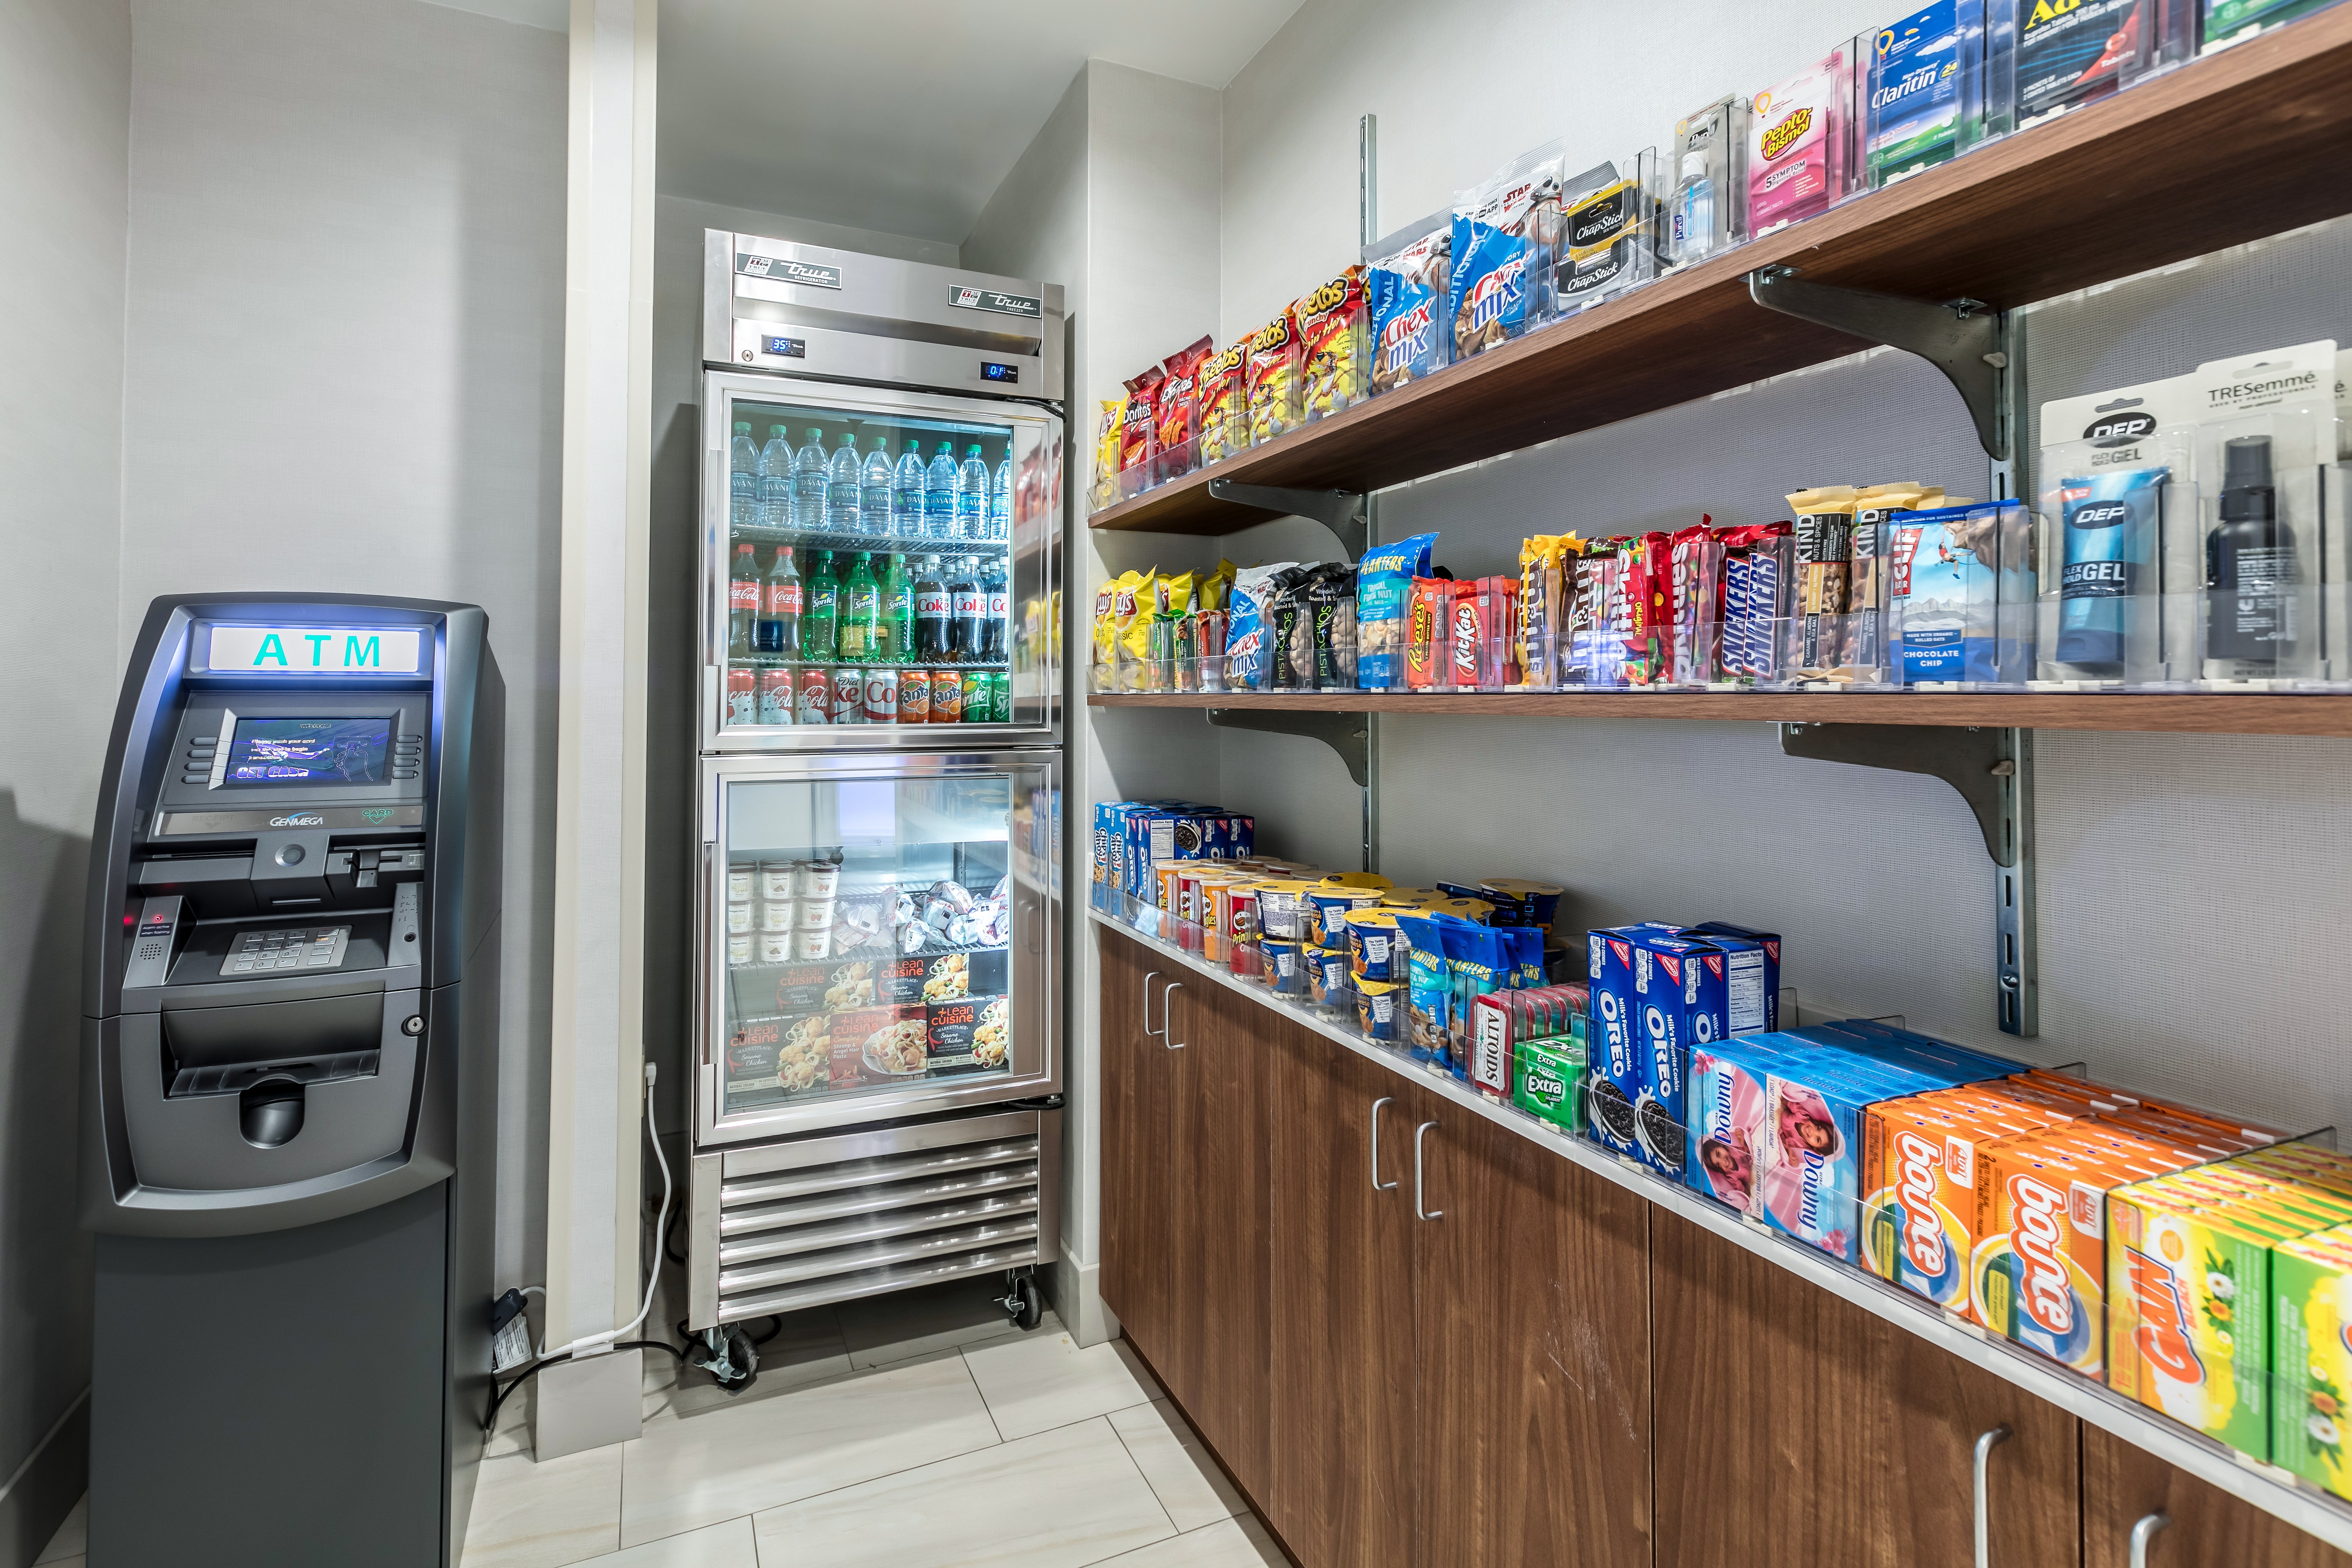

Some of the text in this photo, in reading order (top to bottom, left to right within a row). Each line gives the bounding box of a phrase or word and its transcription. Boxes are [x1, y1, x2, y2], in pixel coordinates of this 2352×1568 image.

[1944, 62, 1957, 73] 24
[1872, 71, 1937, 109] Claritin
[1761, 107, 1813, 151] Pepto-
[1767, 116, 1810, 158] Bismol
[1766, 176, 1772, 188] 5
[1772, 160, 1805, 181] SYMPTOM
[1772, 167, 1805, 186] Digestive Relief
[1486, 204, 1498, 215] APP
[1488, 198, 1498, 207] FORCE
[1579, 250, 1598, 261] ORIGINAL
[794, 275, 828, 284] REFRIGERATOR
[1567, 261, 1617, 291] ChapStick
[1408, 297, 1424, 316] SAVORY
[1385, 303, 1430, 348] Chex
[773, 339, 786, 350] 35
[1389, 329, 1428, 372] mix
[2208, 370, 2317, 401] TRESemmé
[1123, 403, 1151, 424] Doritos
[2092, 418, 2148, 438] DEP
[731, 478, 755, 488] ASANI
[761, 482, 788, 492] DASANI
[801, 477, 828, 488] DASANI
[2076, 506, 2125, 523] DEP
[1814, 516, 1823, 538] SPICES
[1855, 509, 1880, 559] KIND
[1796, 514, 1815, 564] KIND
[1360, 555, 1405, 575] PLANTERS
[1894, 531, 1918, 581] CLIF
[2082, 563, 2126, 581] GEL
[1895, 580, 1908, 589] BAR
[813, 593, 834, 607] Sprite
[853, 597, 874, 610] Sprite
[1378, 590, 1392, 599] NUT
[918, 598, 949, 612] Coke
[1722, 562, 1749, 674] SNICKERS
[1754, 555, 1777, 678] SNICKERS
[1316, 605, 1332, 677] PISTACHIOS
[1408, 601, 1425, 673] Reese's
[252, 633, 380, 667] ATM
[838, 677, 859, 686] Diet
[899, 685, 929, 706] Fanta
[237, 766, 309, 779] GET CASH
[192, 814, 235, 822] RECEIPT
[270, 816, 323, 827] GENMEGA
[362, 808, 394, 817] CARD
[1615, 944, 1627, 960] NABISCO
[881, 968, 924, 979] cuisine
[897, 960, 924, 969] Lean
[1663, 957, 1678, 977] NABISCO
[947, 1005, 974, 1016] Lean
[1618, 997, 1627, 1020] Milk's
[931, 1014, 974, 1026] cuisine
[1598, 990, 1625, 1079] OREO
[1622, 1019, 1630, 1049] Favorite
[1486, 1010, 1500, 1083] ALTOIDS
[1537, 1053, 1557, 1067] Extra
[1528, 1076, 1562, 1095] Extra
[1545, 1095, 1562, 1103] SPEARMINT
[1714, 1071, 1735, 1144] Downy
[1797, 1150, 1825, 1231] Downy
[1898, 1132, 1943, 1274] bounce
[2015, 1177, 2070, 1331] bounce
